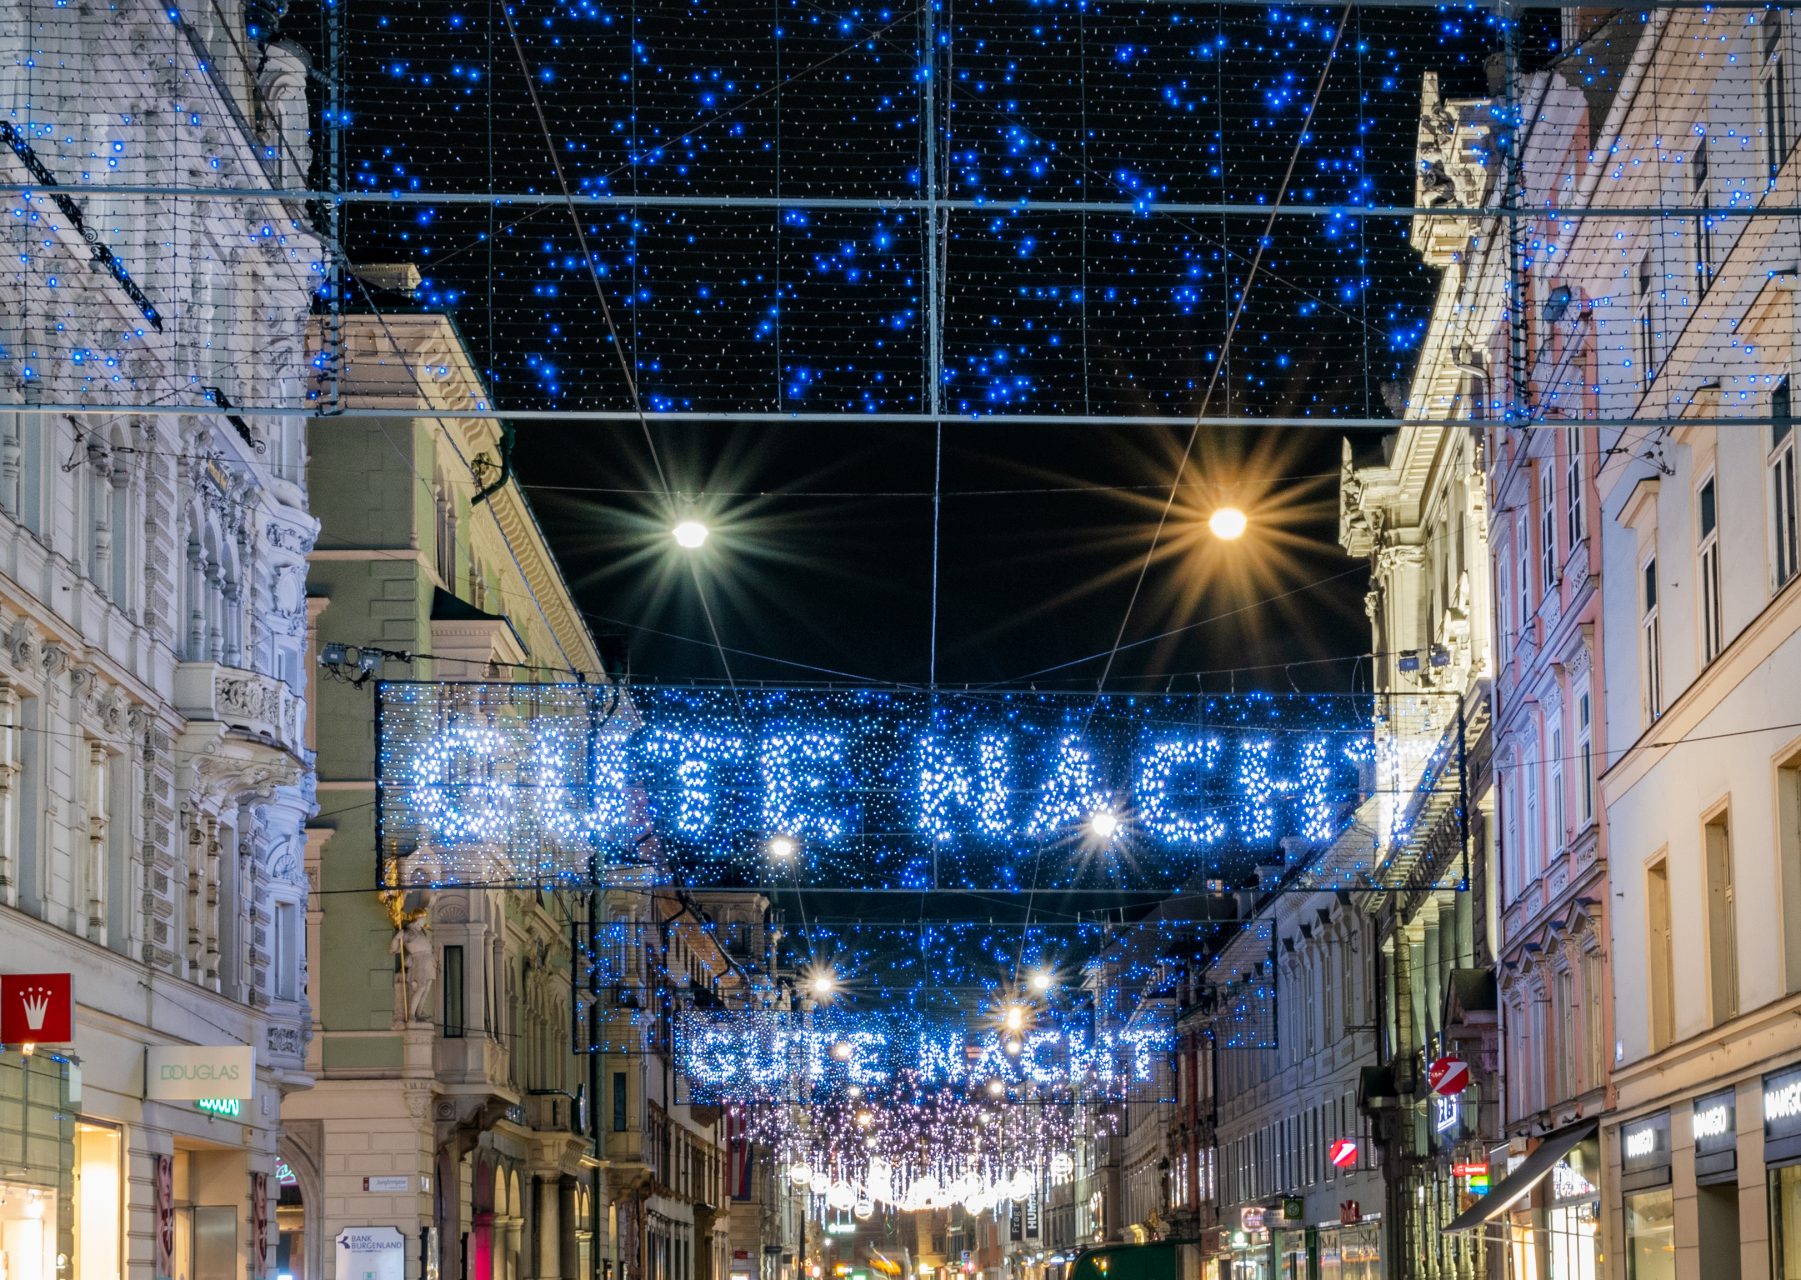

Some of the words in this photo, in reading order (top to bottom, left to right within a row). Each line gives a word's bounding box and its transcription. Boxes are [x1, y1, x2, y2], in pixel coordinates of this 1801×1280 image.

[410, 726, 842, 842] GUTE
[917, 732, 1446, 844] NACHT
[160, 1064, 239, 1080] DOUGLAS
[686, 1030, 889, 1083] GUTE
[919, 1030, 1169, 1084] NACHT
[1693, 1105, 1727, 1140] MANGO
[1627, 1128, 1654, 1158] MANGO
